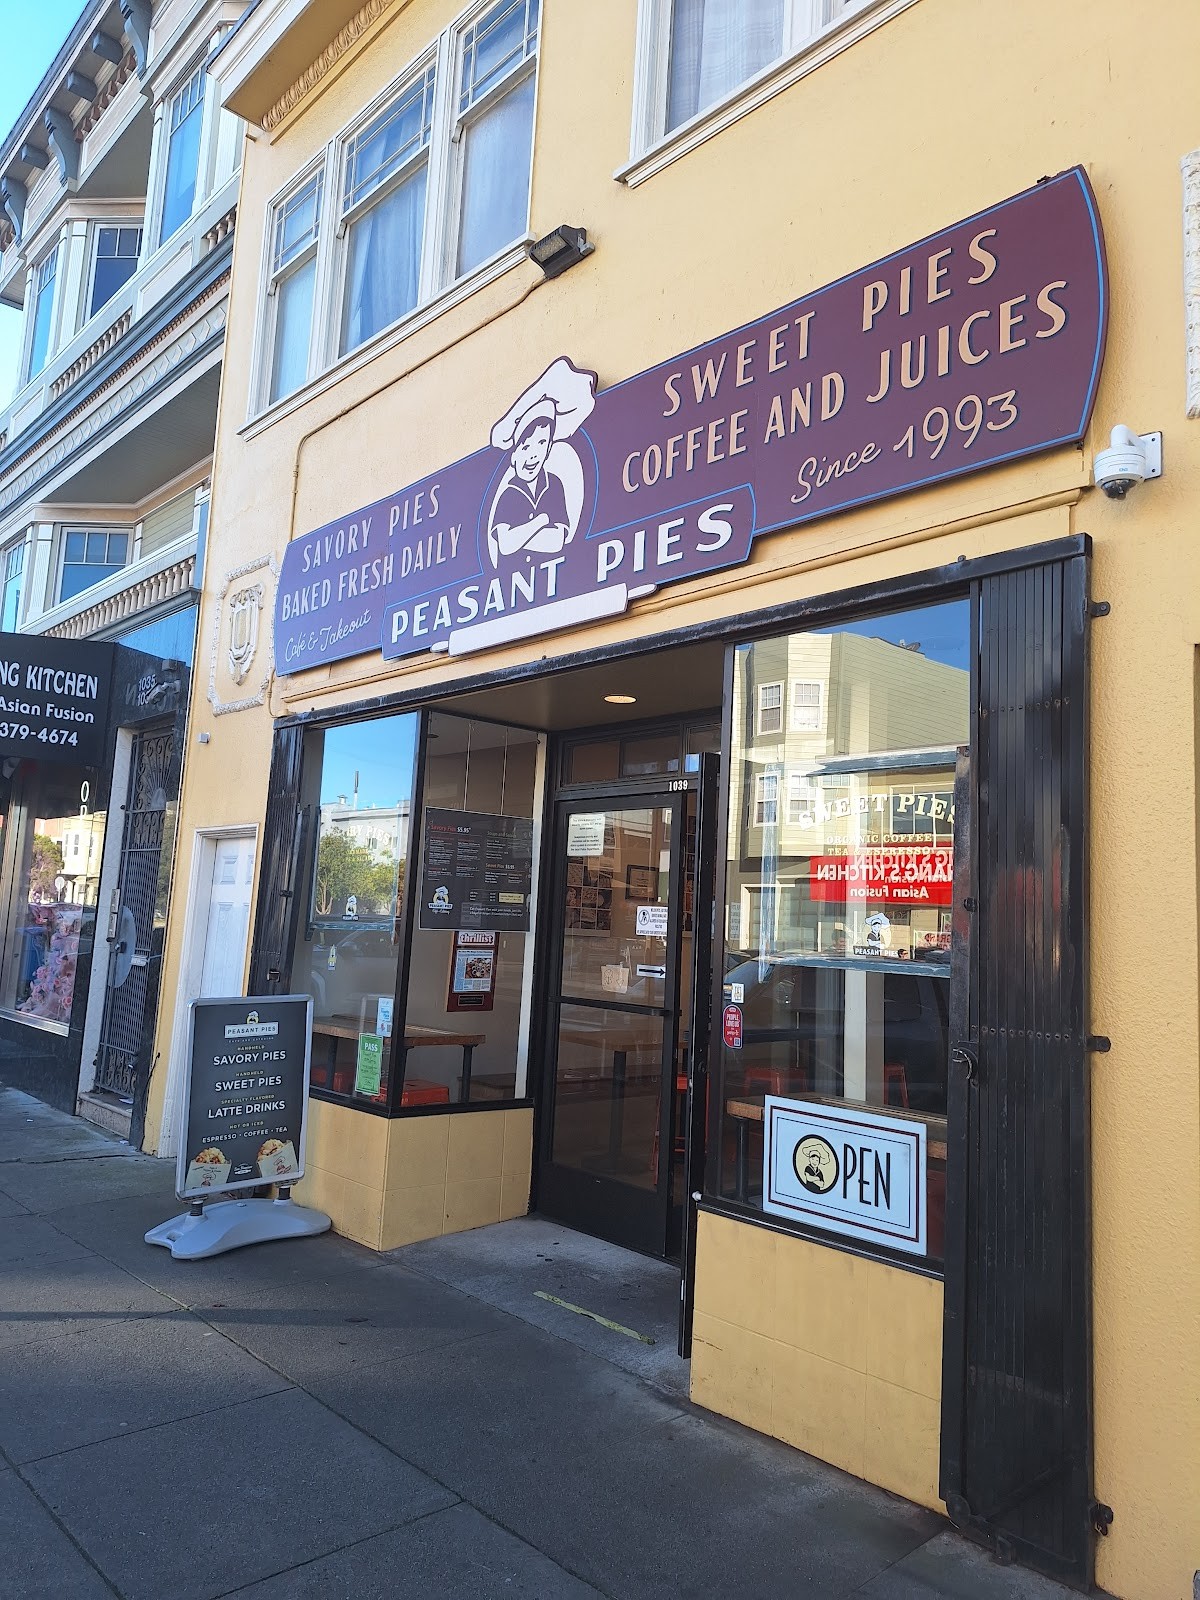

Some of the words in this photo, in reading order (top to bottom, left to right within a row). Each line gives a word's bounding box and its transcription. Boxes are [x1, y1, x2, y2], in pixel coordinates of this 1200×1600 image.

[663, 310, 816, 417] SWEET
[862, 228, 997, 333] PIES
[621, 408, 748, 493] COFFEE
[763, 371, 846, 444] AND
[866, 280, 1069, 403] JUICES
[790, 441, 881, 505] Since
[893, 388, 1019, 461] 1993
[302, 517, 372, 574] SAVORY
[388, 484, 440, 537] PIES
[281, 578, 332, 622] BAKED
[338, 552, 395, 602] FRESH
[401, 523, 462, 578] DAILY
[391, 555, 566, 644] PEASANT
[596, 503, 735, 583] PIES
[285, 628, 307, 662] Café
[308, 634, 319, 649] &
[320, 608, 372, 651] Takeout
[26, 665, 98, 699] KITCHEN
[138, 674, 156, 691] 1035
[0, 696, 41, 716] Asian
[45, 702, 94, 723] Fusion
[0, 722, 78, 746] 379-4674
[668, 779, 688, 791] 1039
[799, 794, 887, 830] SWEET
[826, 834, 879, 845] ORGANIC
[883, 833, 932, 843] COFFEE
[828, 848, 848, 856] TEA
[866, 846, 931, 856] ESPRESSO
[460, 932, 493, 944] thrillist
[213, 1052, 259, 1066] SAVORY
[262, 1050, 286, 1061] PIES
[364, 1042, 378, 1052] PASS
[215, 1079, 255, 1092] SWEET
[258, 1076, 281, 1087] PIES
[208, 1105, 242, 1119] LATTE
[245, 1100, 285, 1114] DRINKS
[202, 1134, 237, 1143] ESPRESSO
[243, 1128, 269, 1138] COFFEE
[792, 1134, 891, 1210] OPEN
